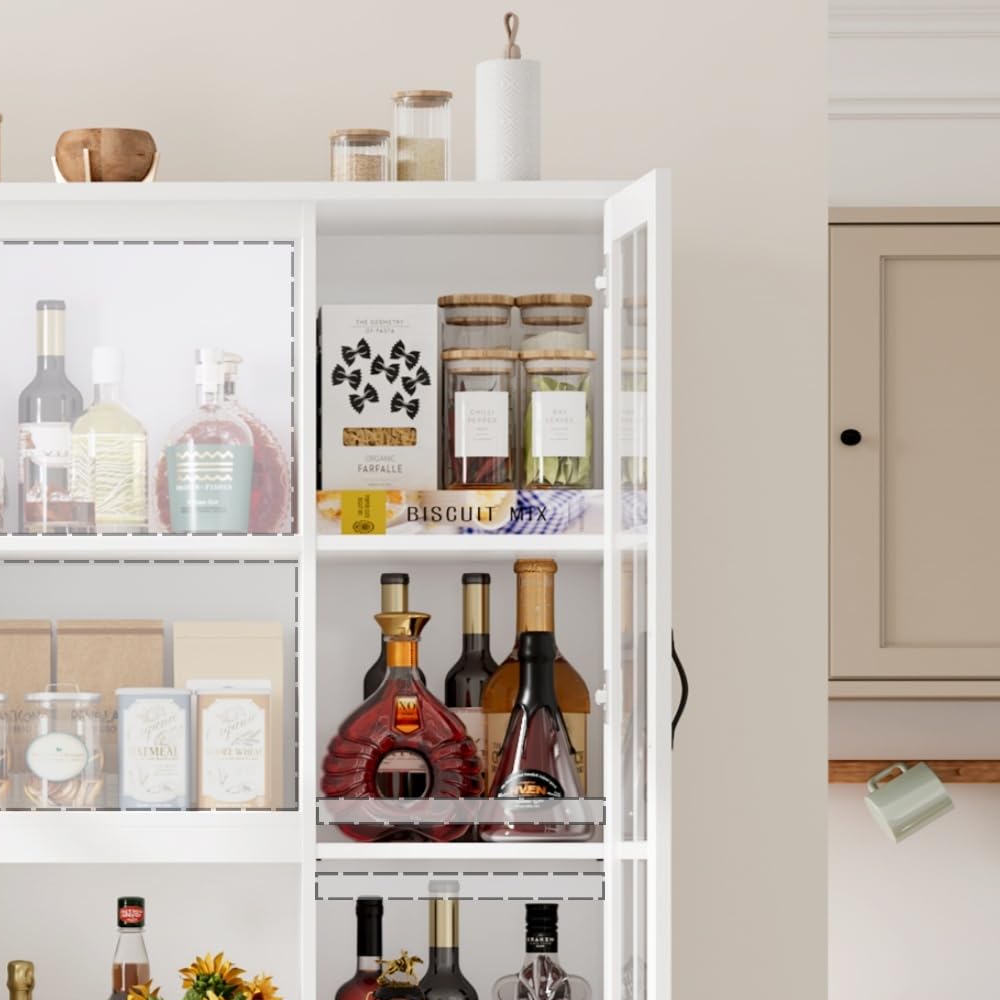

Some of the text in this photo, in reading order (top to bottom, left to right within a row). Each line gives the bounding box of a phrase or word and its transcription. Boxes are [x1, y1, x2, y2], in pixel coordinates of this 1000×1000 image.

[357, 463, 403, 474] FARFALLE
[407, 506, 547, 521] BISCUIT MIX
